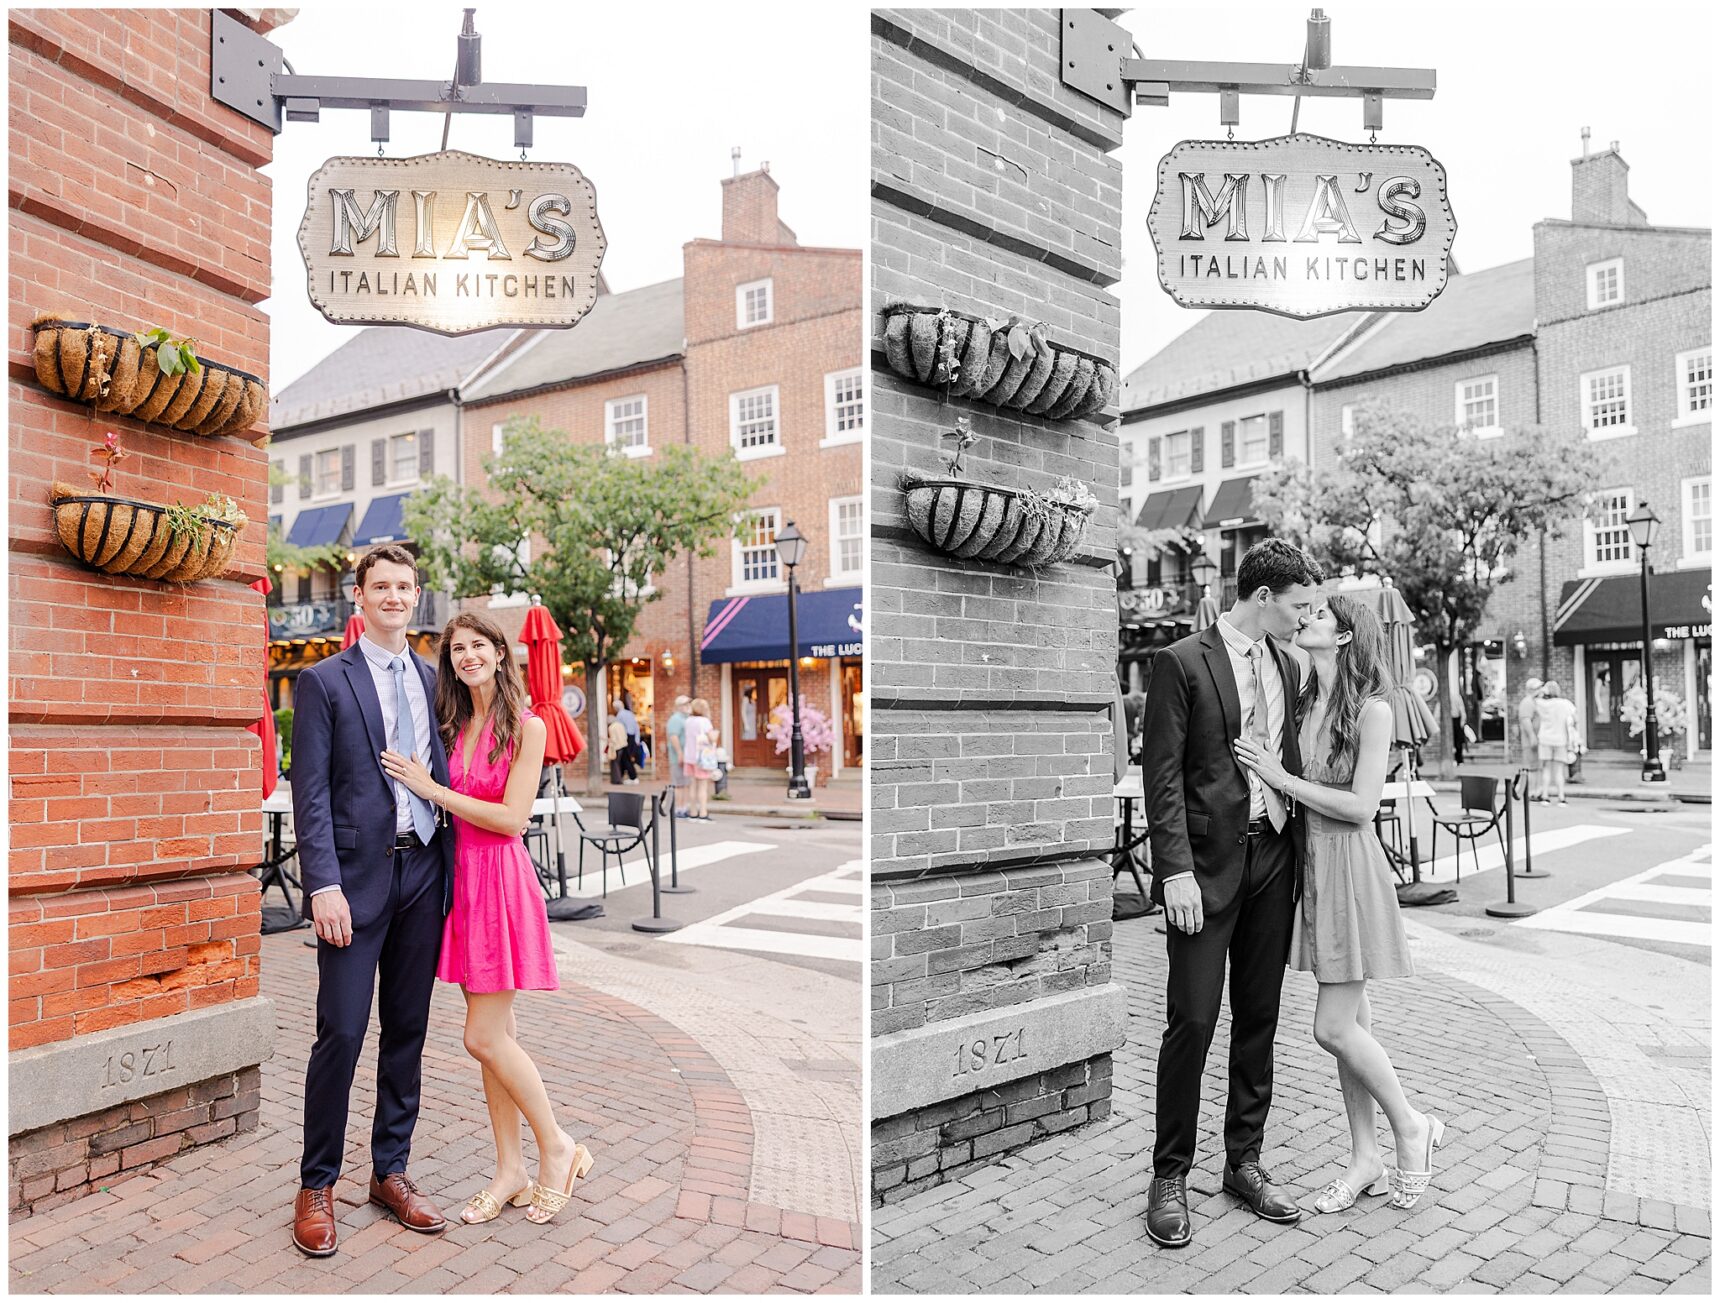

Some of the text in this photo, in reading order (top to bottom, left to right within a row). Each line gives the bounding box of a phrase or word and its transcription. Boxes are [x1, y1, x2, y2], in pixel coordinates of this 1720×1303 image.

[328, 188, 577, 263] MIA'S
[1178, 172, 1427, 246] MIA'S
[330, 270, 575, 299] ITALIAN KITCHEN
[1180, 254, 1425, 281] ITALIAN KITCHEN
[811, 644, 836, 657] THE
[1664, 626, 1689, 639] THE
[101, 1039, 176, 1089] 1871
[952, 1027, 1028, 1077] 1871
